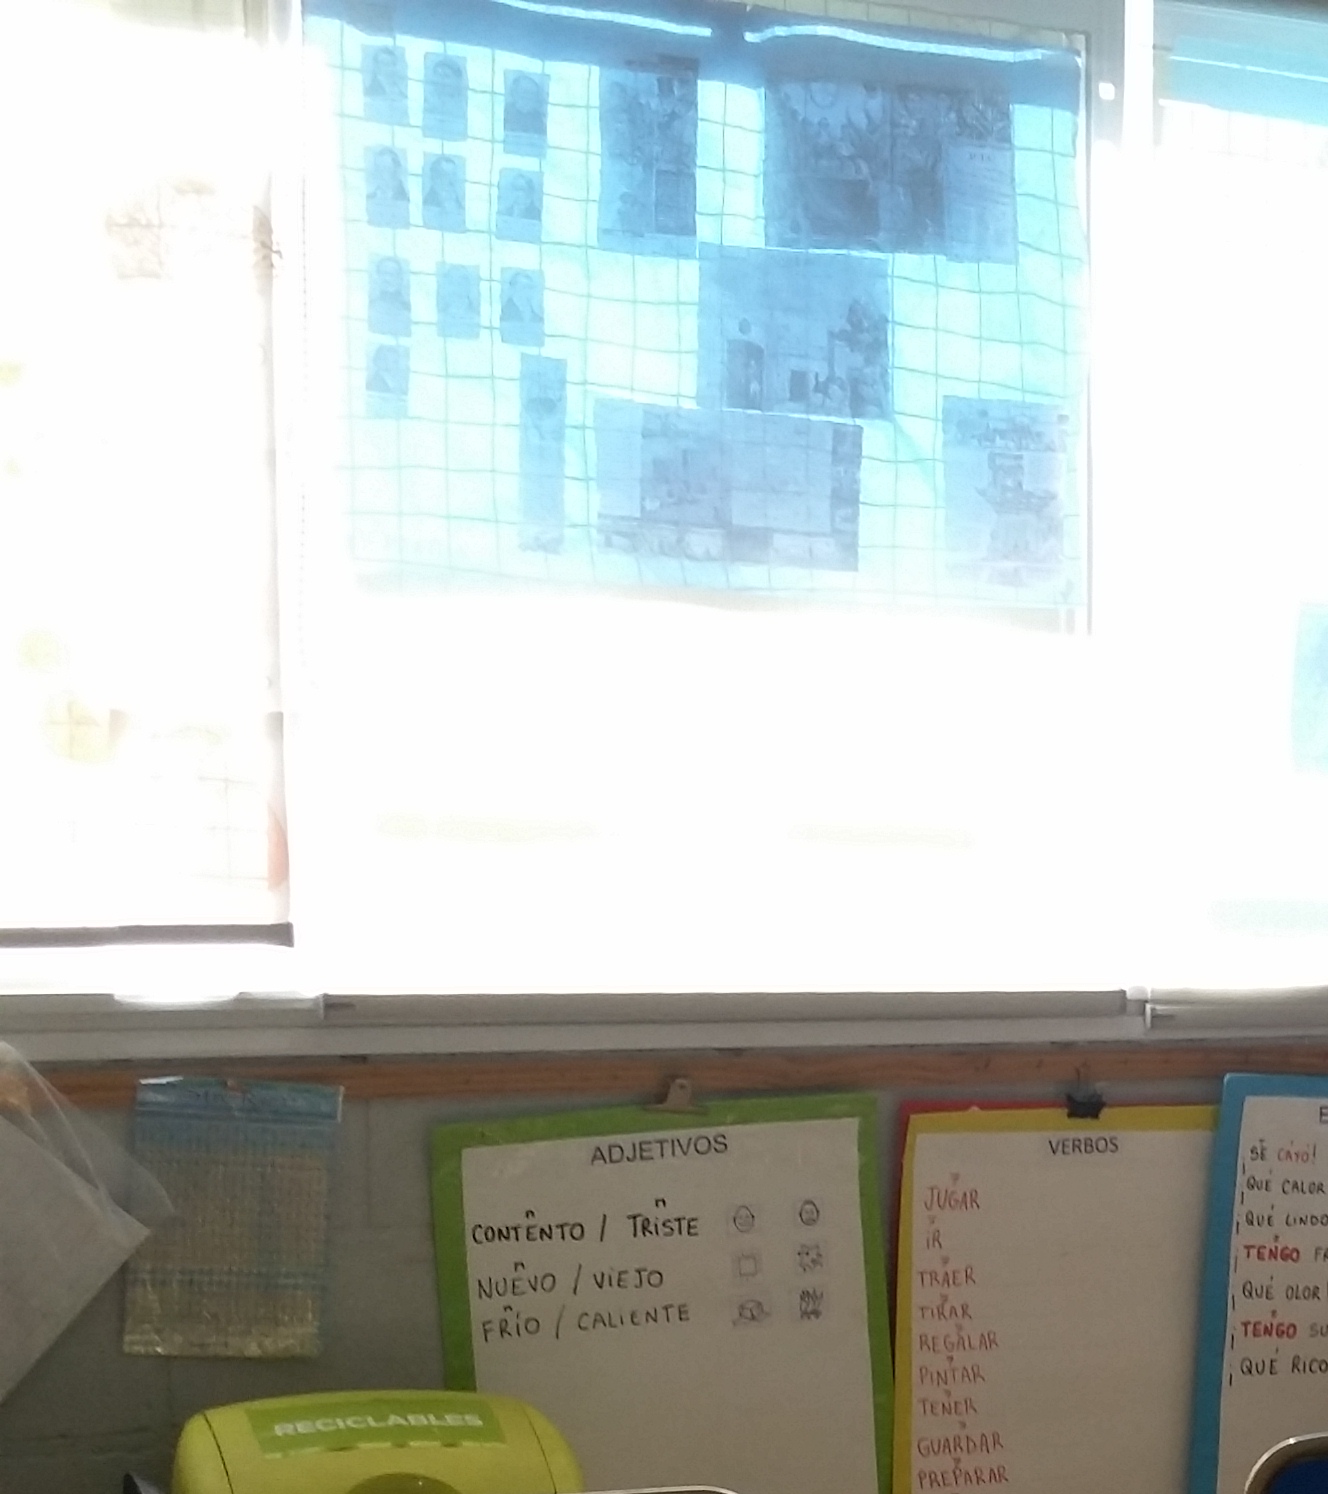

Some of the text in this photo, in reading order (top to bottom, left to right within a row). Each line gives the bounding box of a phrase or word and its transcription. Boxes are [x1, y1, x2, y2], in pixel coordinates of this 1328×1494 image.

[590, 1133, 729, 1166] ADJETIVOS
[1047, 1136, 1120, 1157] VERBOS
[923, 1184, 981, 1212] JUGAR
[471, 1220, 586, 1245] CONTENTO
[476, 1270, 557, 1301] NUEVO
[917, 1265, 977, 1290] TRAER
[577, 1303, 691, 1333] CALIENTE
[917, 1330, 1000, 1355] REGALAR
[918, 1363, 986, 1388] PINTAR
[917, 1396, 979, 1418] TENER
[274, 1412, 485, 1438] RECICLABLES
[916, 1431, 1005, 1459] GUARDAR
[916, 1464, 1010, 1491] PREPARAR
